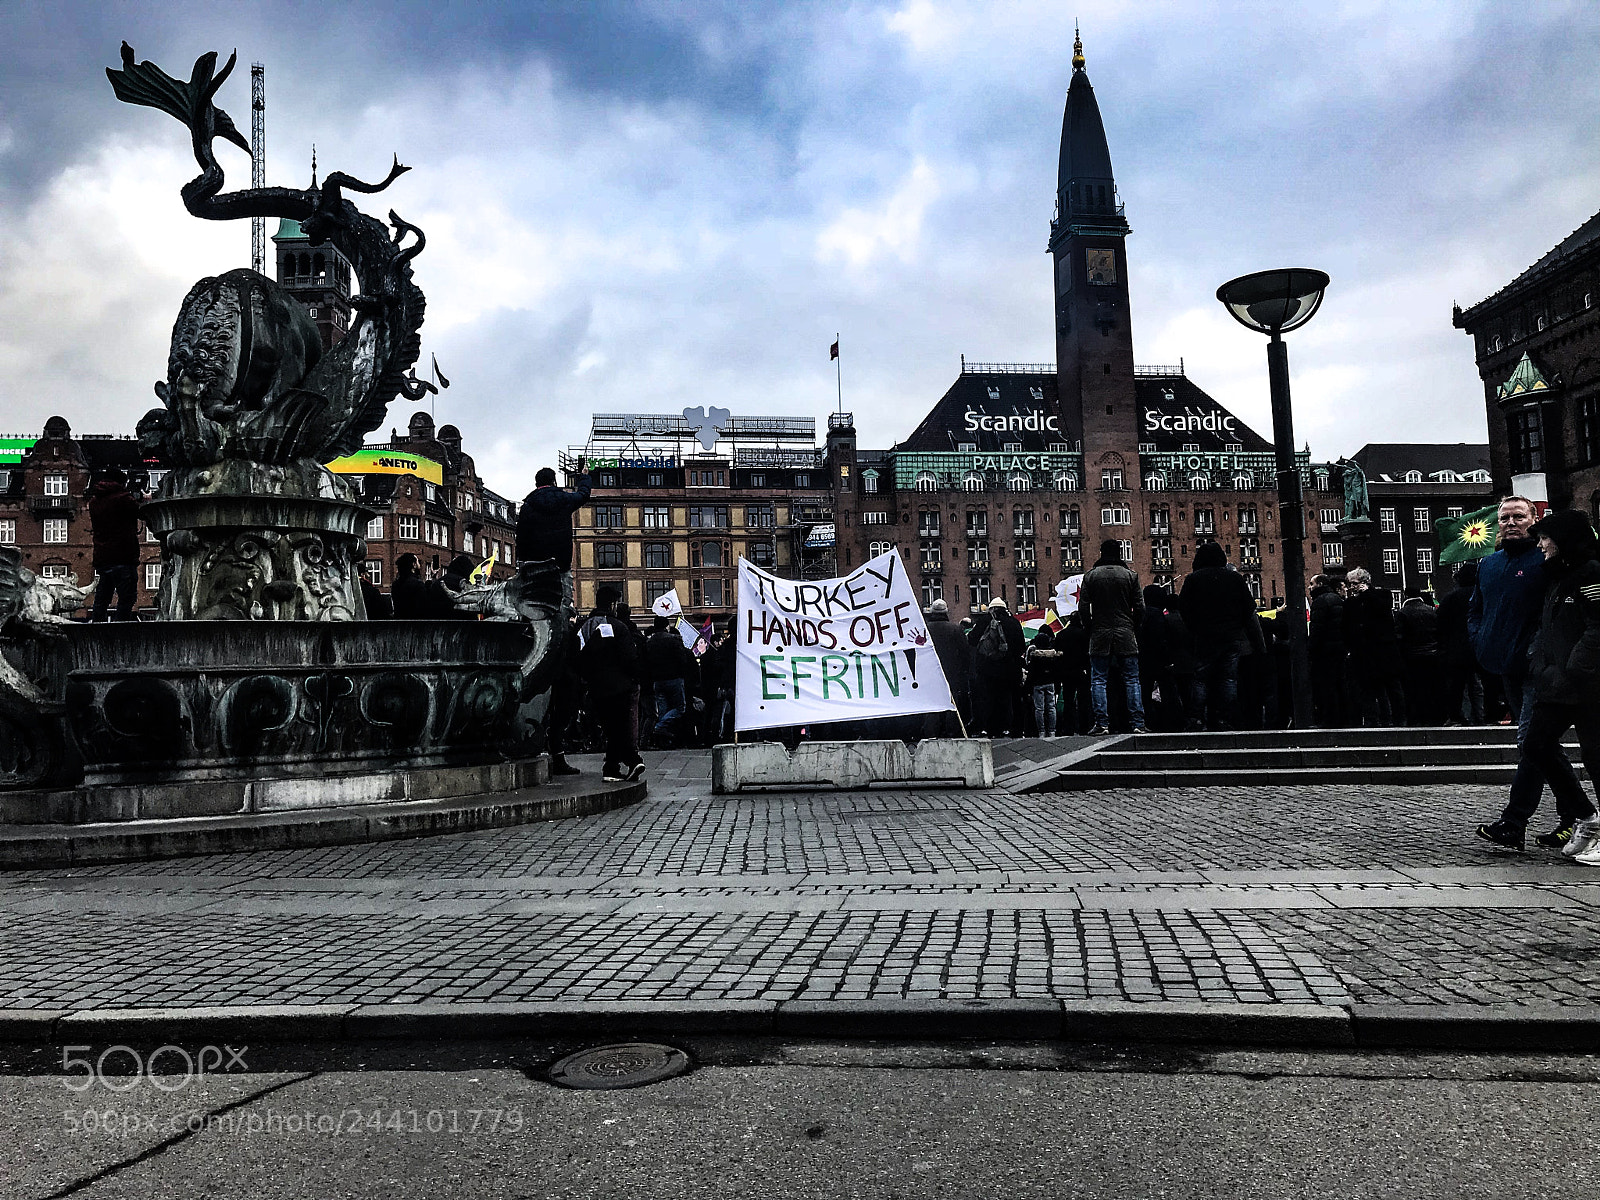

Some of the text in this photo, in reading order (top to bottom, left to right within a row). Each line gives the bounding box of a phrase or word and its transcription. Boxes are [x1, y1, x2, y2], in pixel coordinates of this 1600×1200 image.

[964, 410, 1059, 431] Scandic
[1145, 410, 1235, 431] Scandic
[385, 458, 418, 471] NETTO
[578, 455, 675, 471] ycamobile
[738, 452, 822, 463] REKLAMEPLADS
[973, 456, 1243, 471] PALACE HOTEL
[746, 555, 896, 617] TURKEY
[748, 601, 911, 649] HANDS OFF
